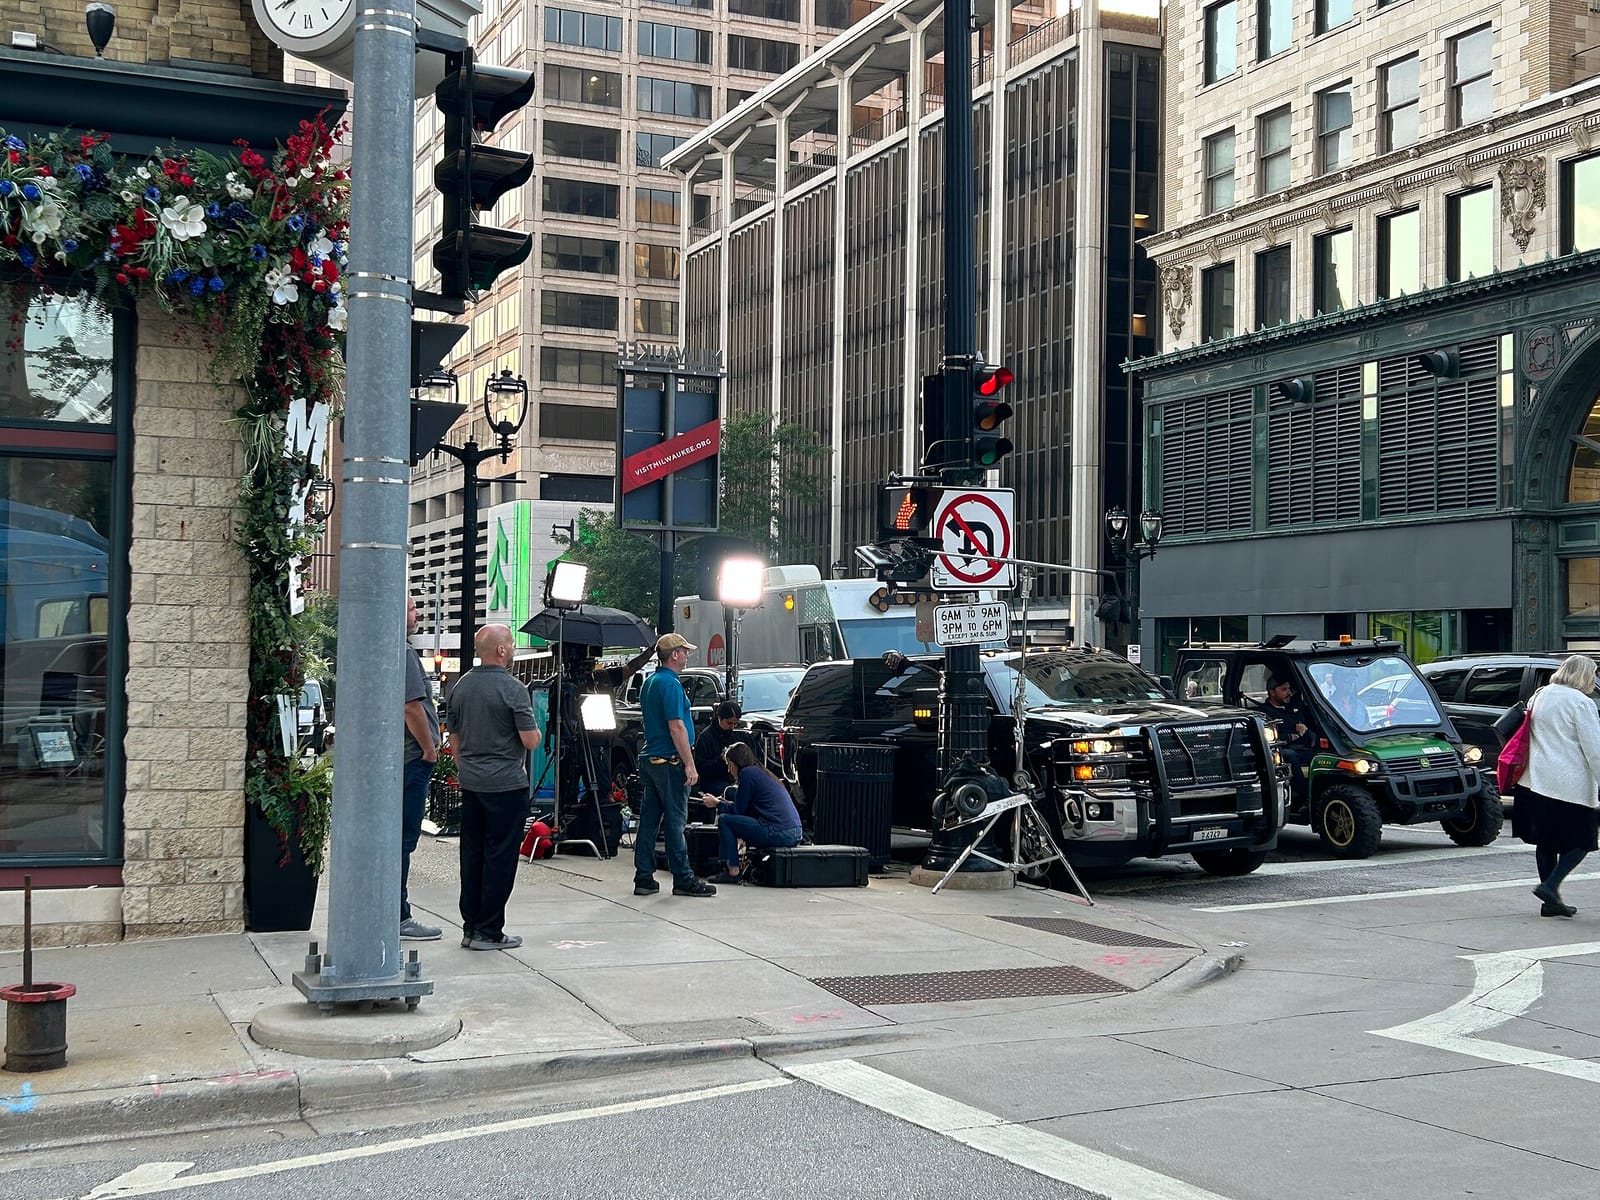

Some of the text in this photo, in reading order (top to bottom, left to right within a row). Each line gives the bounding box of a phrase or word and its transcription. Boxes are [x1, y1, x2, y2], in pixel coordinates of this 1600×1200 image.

[634, 438, 712, 476] VISITMILWAUKEE.ORG
[941, 607, 1001, 621] 6AM TO 9AM
[942, 620, 1003, 634] 3PM TO 6PM
